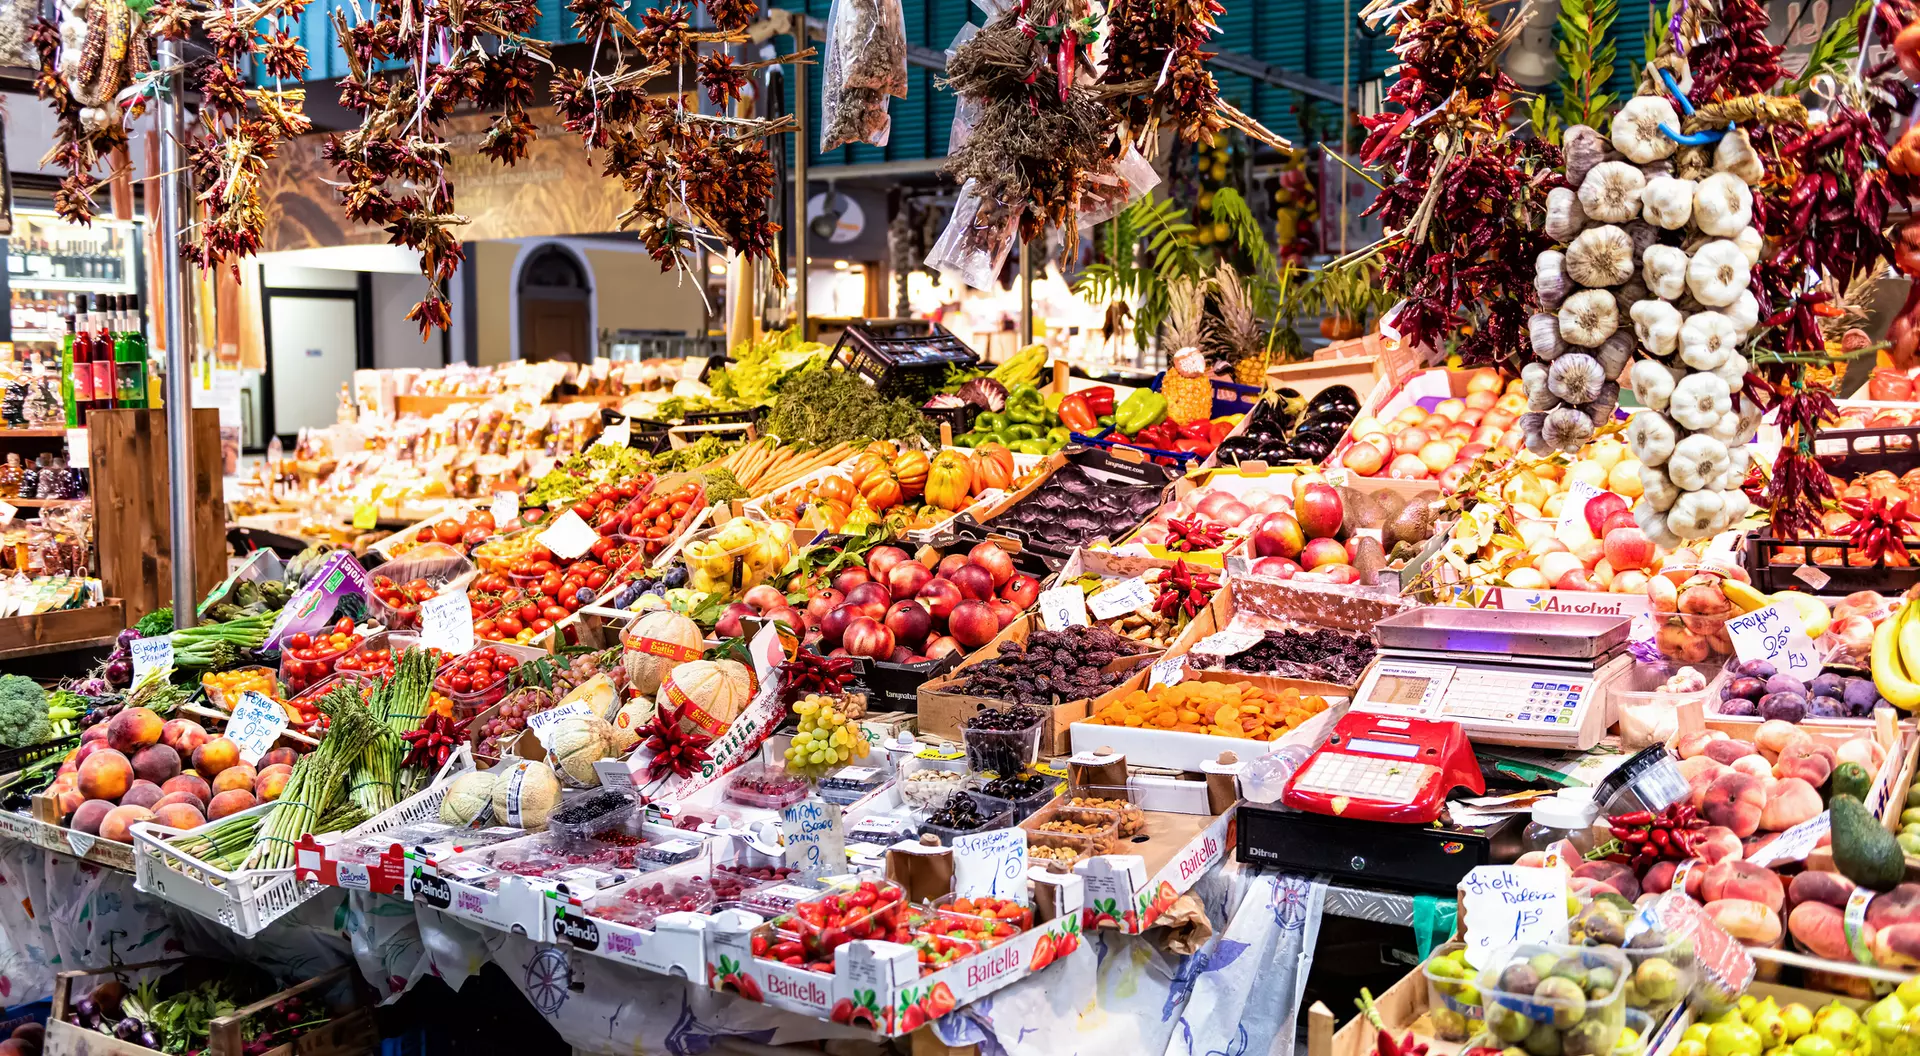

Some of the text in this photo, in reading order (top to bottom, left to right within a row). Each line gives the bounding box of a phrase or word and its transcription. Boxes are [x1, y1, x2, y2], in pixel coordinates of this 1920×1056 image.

[1179, 836, 1219, 880] Baitella
[1249, 847, 1279, 859] Ditron
[967, 945, 1020, 988] Baitella
[766, 972, 827, 1006] Baitella
